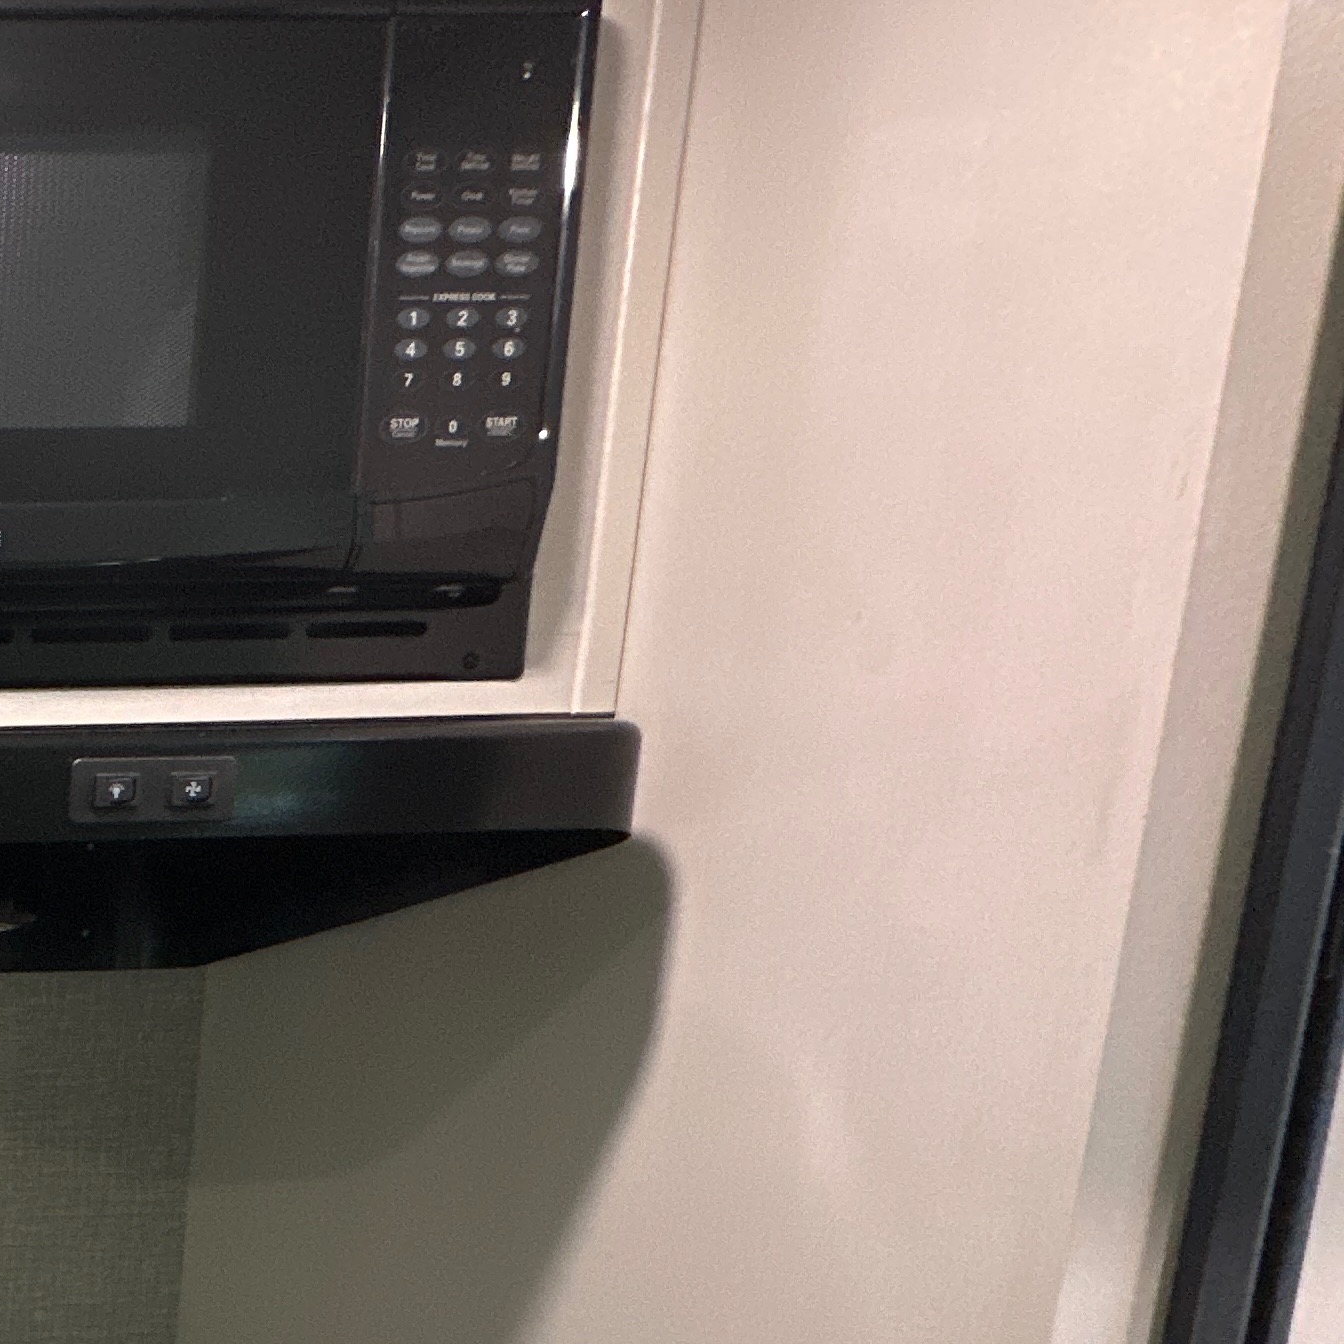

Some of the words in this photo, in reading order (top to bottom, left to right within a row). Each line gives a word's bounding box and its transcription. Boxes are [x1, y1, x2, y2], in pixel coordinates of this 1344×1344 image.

[409, 310, 419, 326] 1
[456, 309, 469, 326] 2
[506, 309, 518, 326] 3
[404, 341, 416, 357] 4
[454, 341, 466, 357] 5
[503, 340, 515, 357] 6
[403, 372, 414, 387] 7
[452, 371, 463, 387] 8
[500, 371, 512, 387] 9
[389, 417, 420, 429] STOP
[448, 419, 458, 434] 0
[485, 416, 518, 429] START
